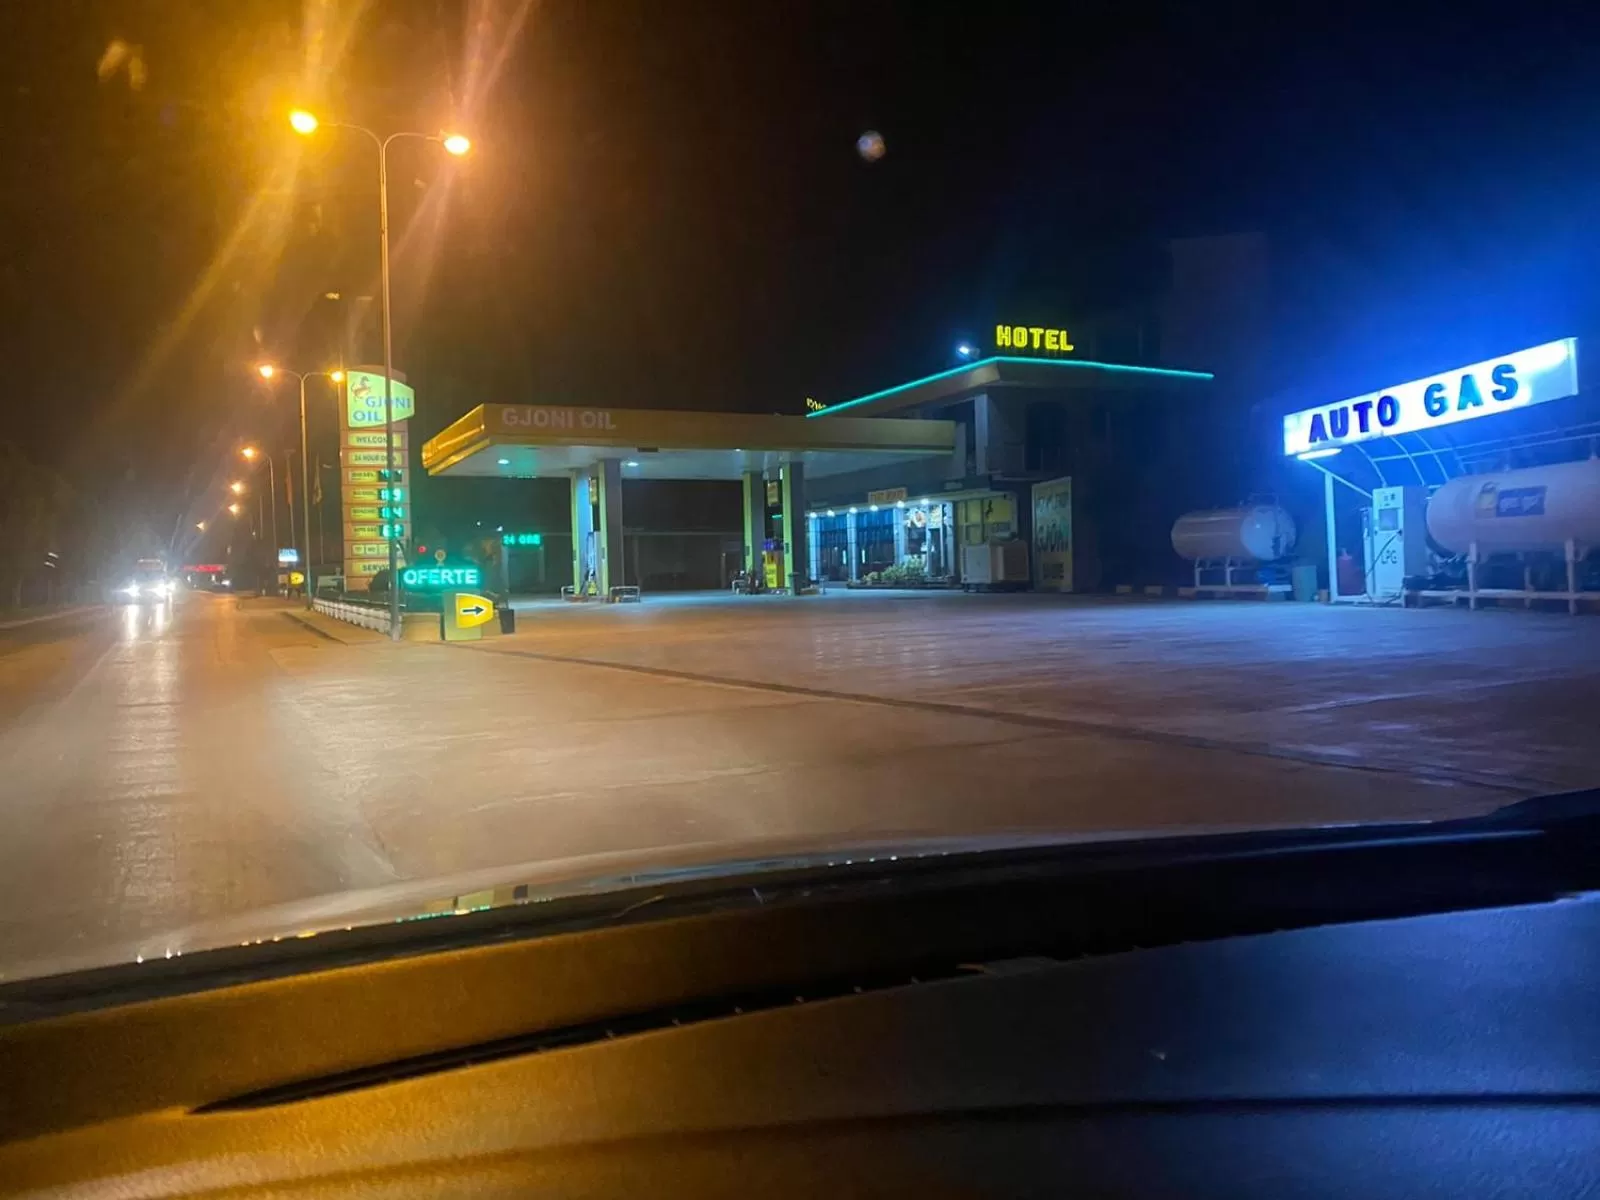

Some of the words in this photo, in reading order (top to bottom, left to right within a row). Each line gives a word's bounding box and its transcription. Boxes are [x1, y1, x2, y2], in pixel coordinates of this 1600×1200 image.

[996, 325, 1074, 351] HOTEL
[366, 396, 411, 409] GJNI
[1308, 394, 1400, 443] AUTO
[1424, 364, 1519, 418] GAS
[353, 410, 383, 422] OIL
[502, 407, 575, 429] GJONI
[581, 410, 617, 430] OIL
[1381, 549, 1398, 565] LPG
[403, 568, 478, 585] OFERTE
